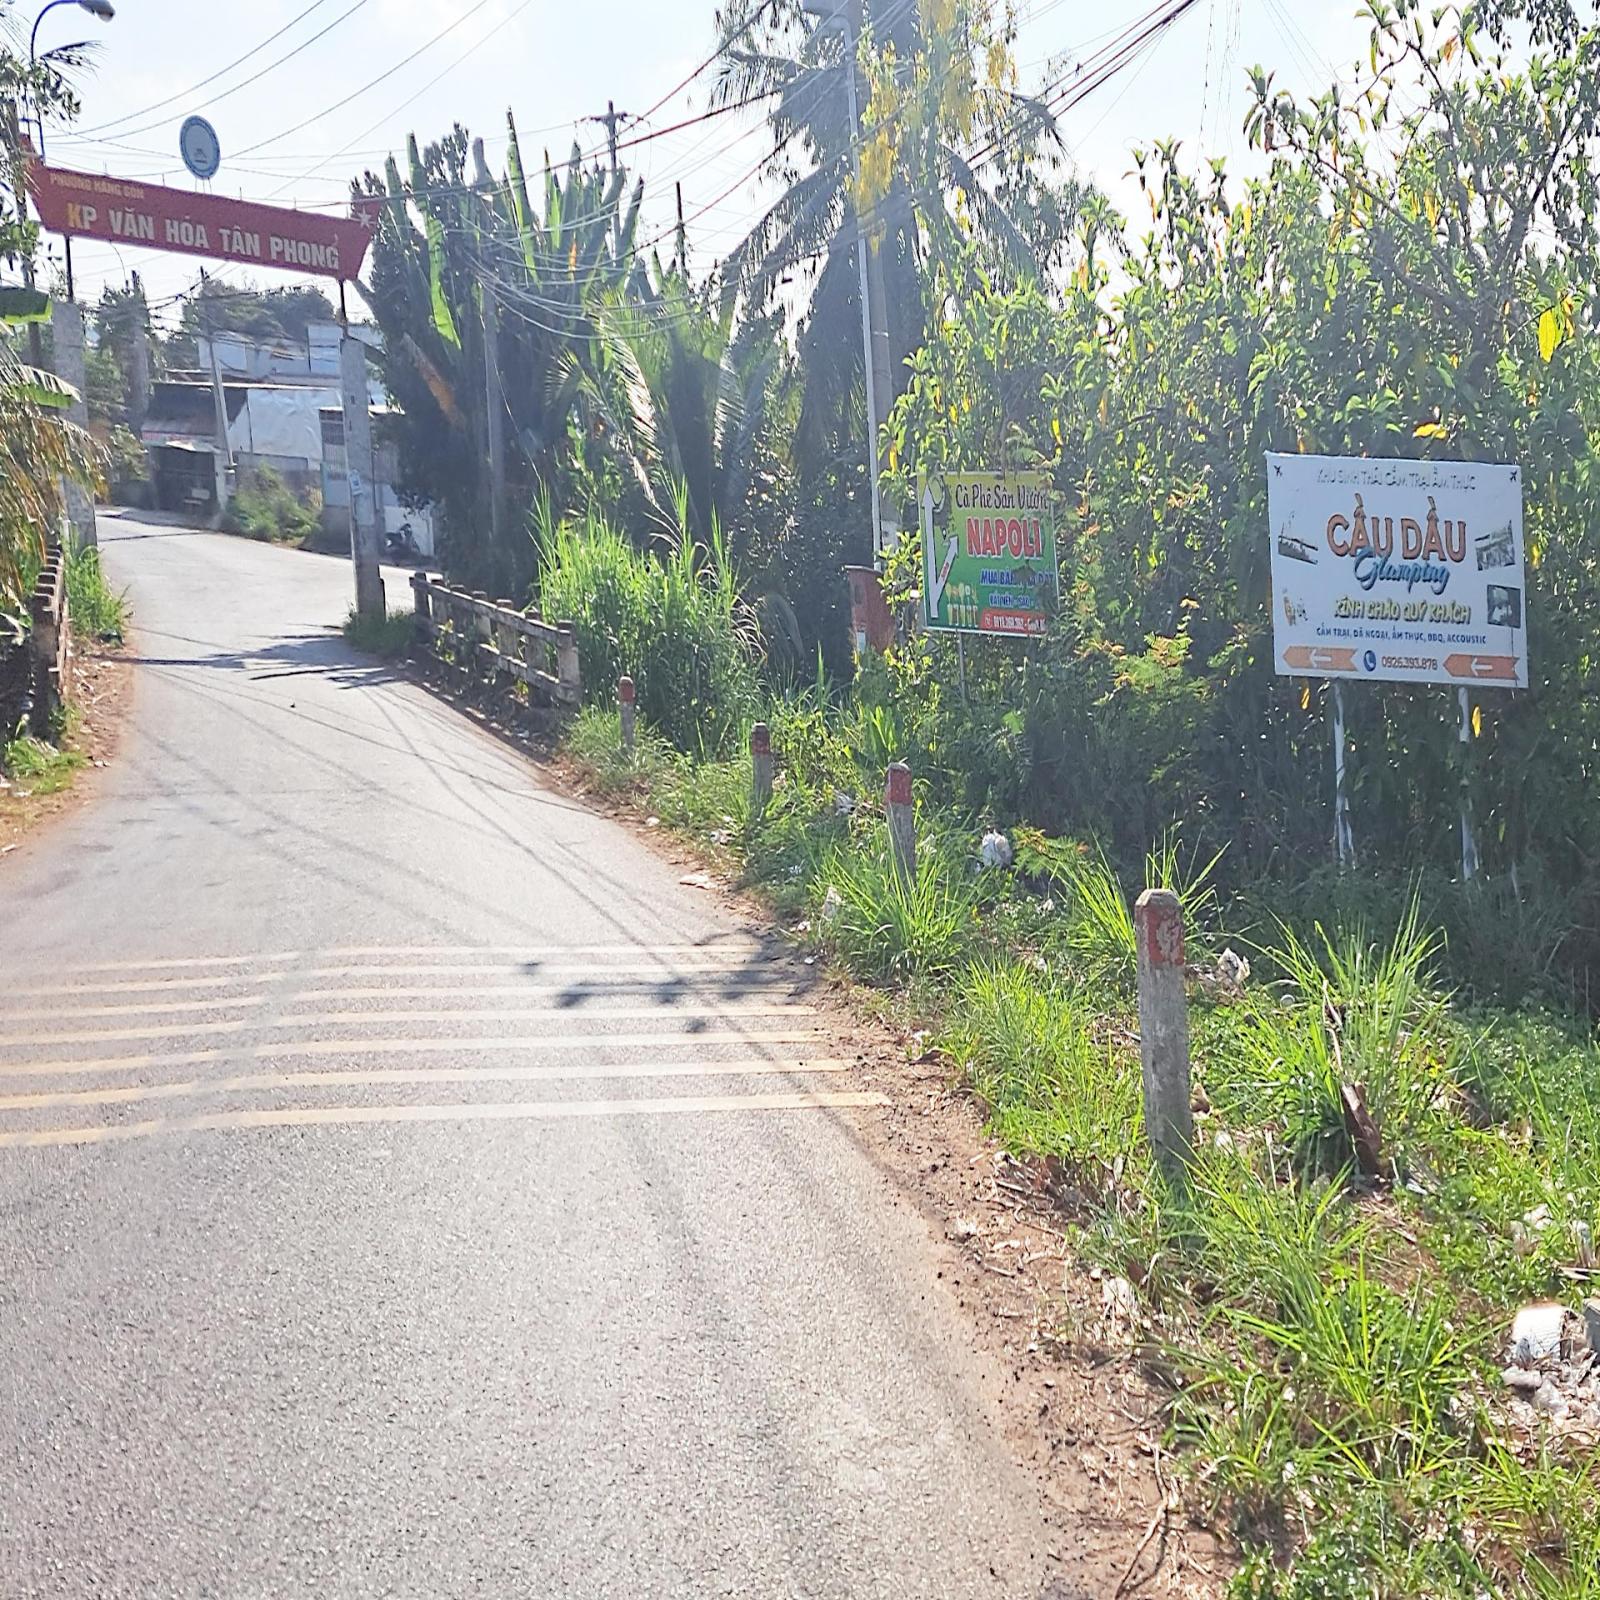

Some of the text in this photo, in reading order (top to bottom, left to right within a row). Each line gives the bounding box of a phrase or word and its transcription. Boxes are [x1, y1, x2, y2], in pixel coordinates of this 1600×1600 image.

[67, 202, 340, 270] KP VĂN HÓA TÂN PHONG
[955, 483, 970, 509] Cà
[972, 483, 992, 509] Phê
[994, 484, 1016, 510] Sân
[966, 516, 1042, 560] NAPOLI
[1327, 493, 1467, 563] CẦU DẦU
[1354, 547, 1450, 595] Glamping
[1334, 597, 1471, 624] KÍNH CHÀO QUÝ KHÁCH
[1447, 634, 1487, 645] ACCOUSTIC
